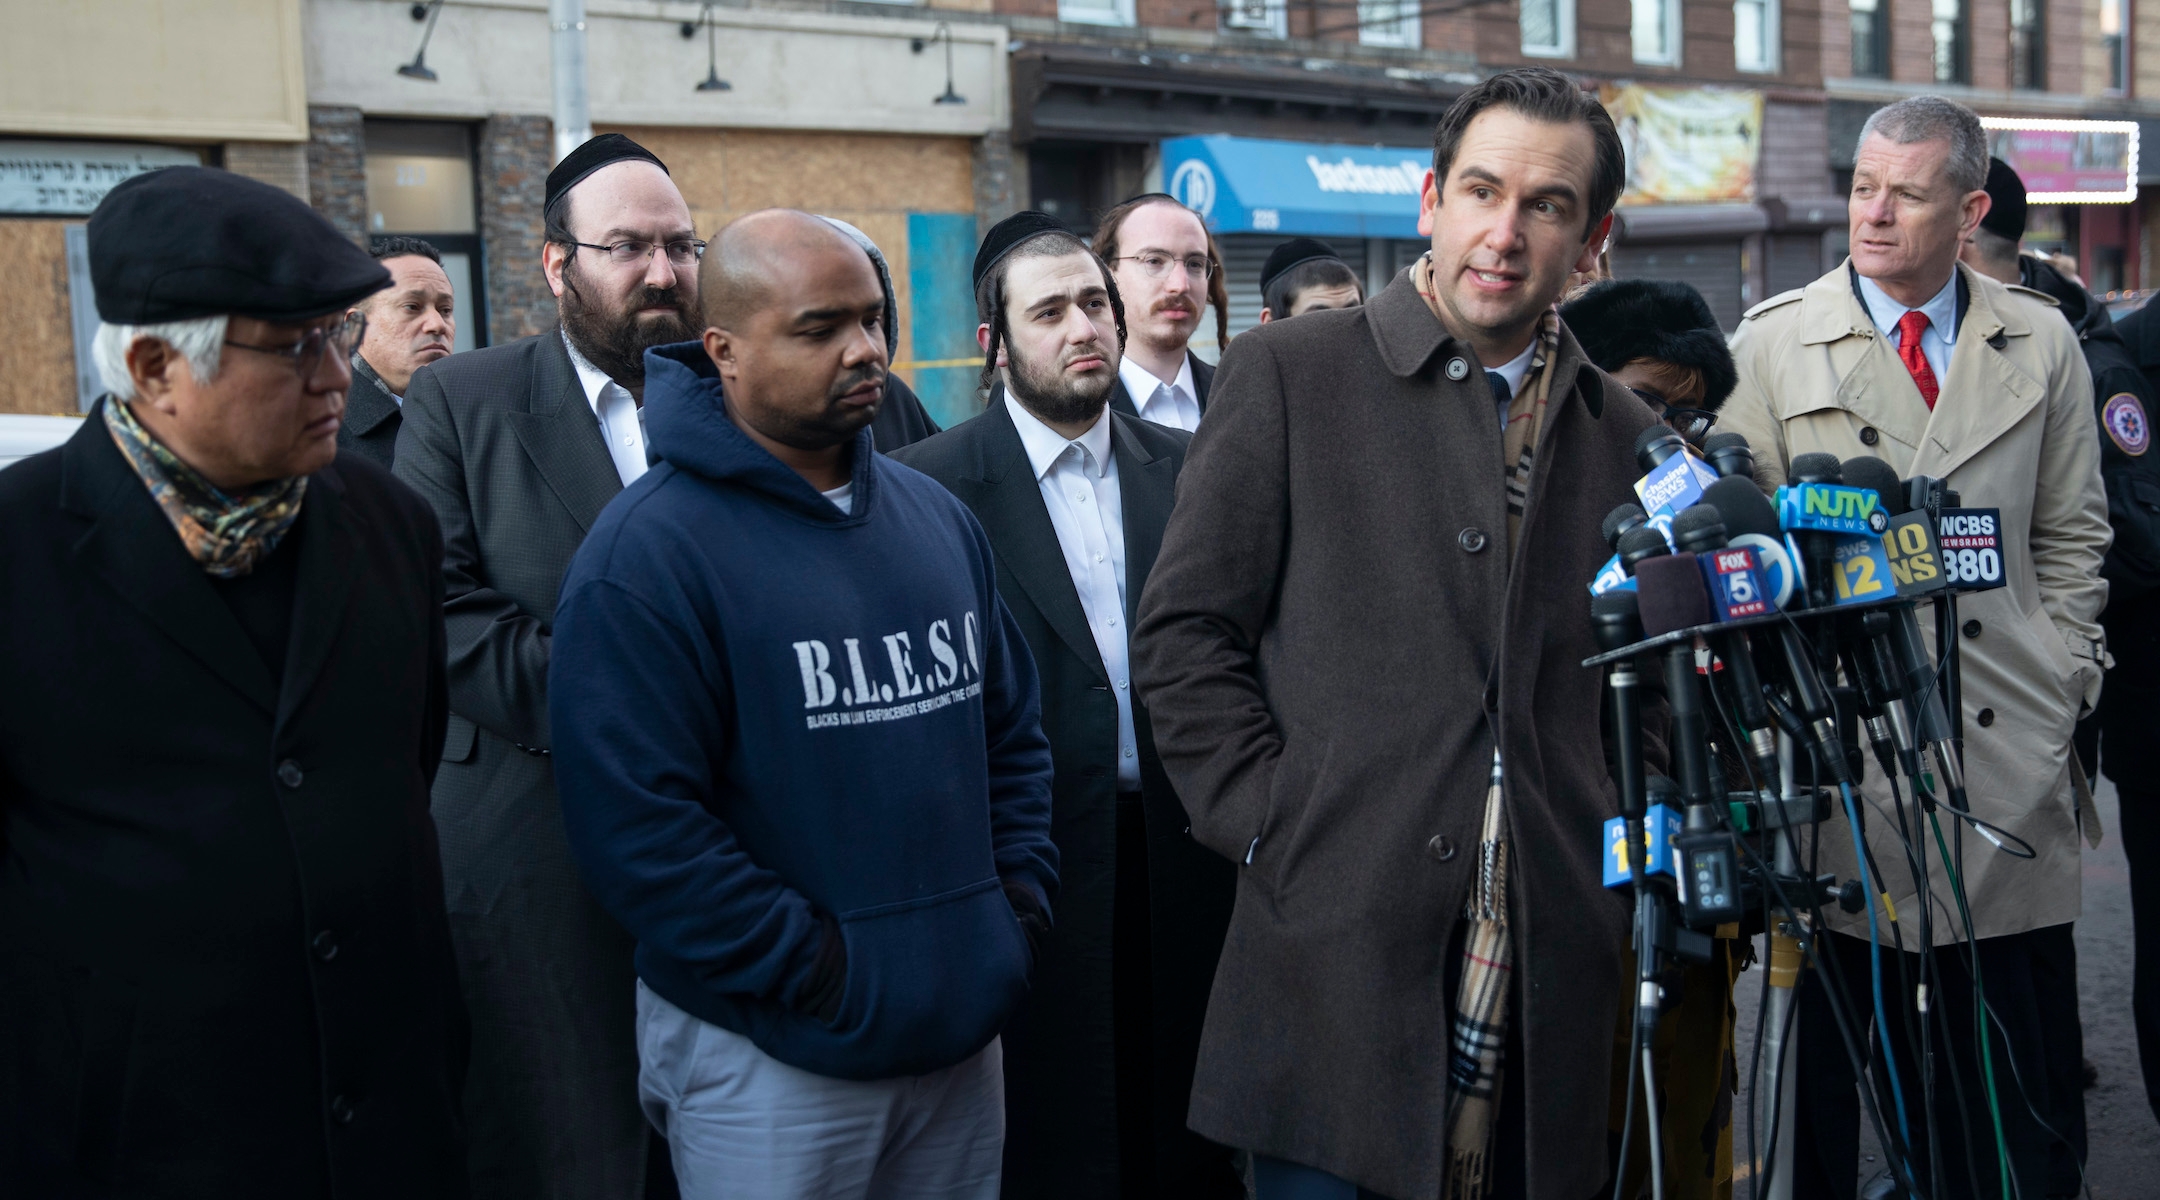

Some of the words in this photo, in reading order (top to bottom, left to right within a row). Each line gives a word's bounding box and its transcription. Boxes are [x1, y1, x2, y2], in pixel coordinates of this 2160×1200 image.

[1644, 462, 1689, 499] chasing
[1647, 475, 1687, 508] news
[1805, 486, 1878, 520] NJTV
[1819, 517, 1866, 531] NEWS
[1718, 551, 1749, 572] FOX
[1834, 540, 1871, 559] ews
[1729, 570, 1753, 603] 5
[1832, 555, 1883, 600] 12
[1730, 602, 1764, 615] NEWS
[806, 712, 840, 730] BLACKS
[840, 711, 851, 725] IN
[864, 702, 918, 723] ENFORCEMENT
[950, 687, 966, 703] THE
